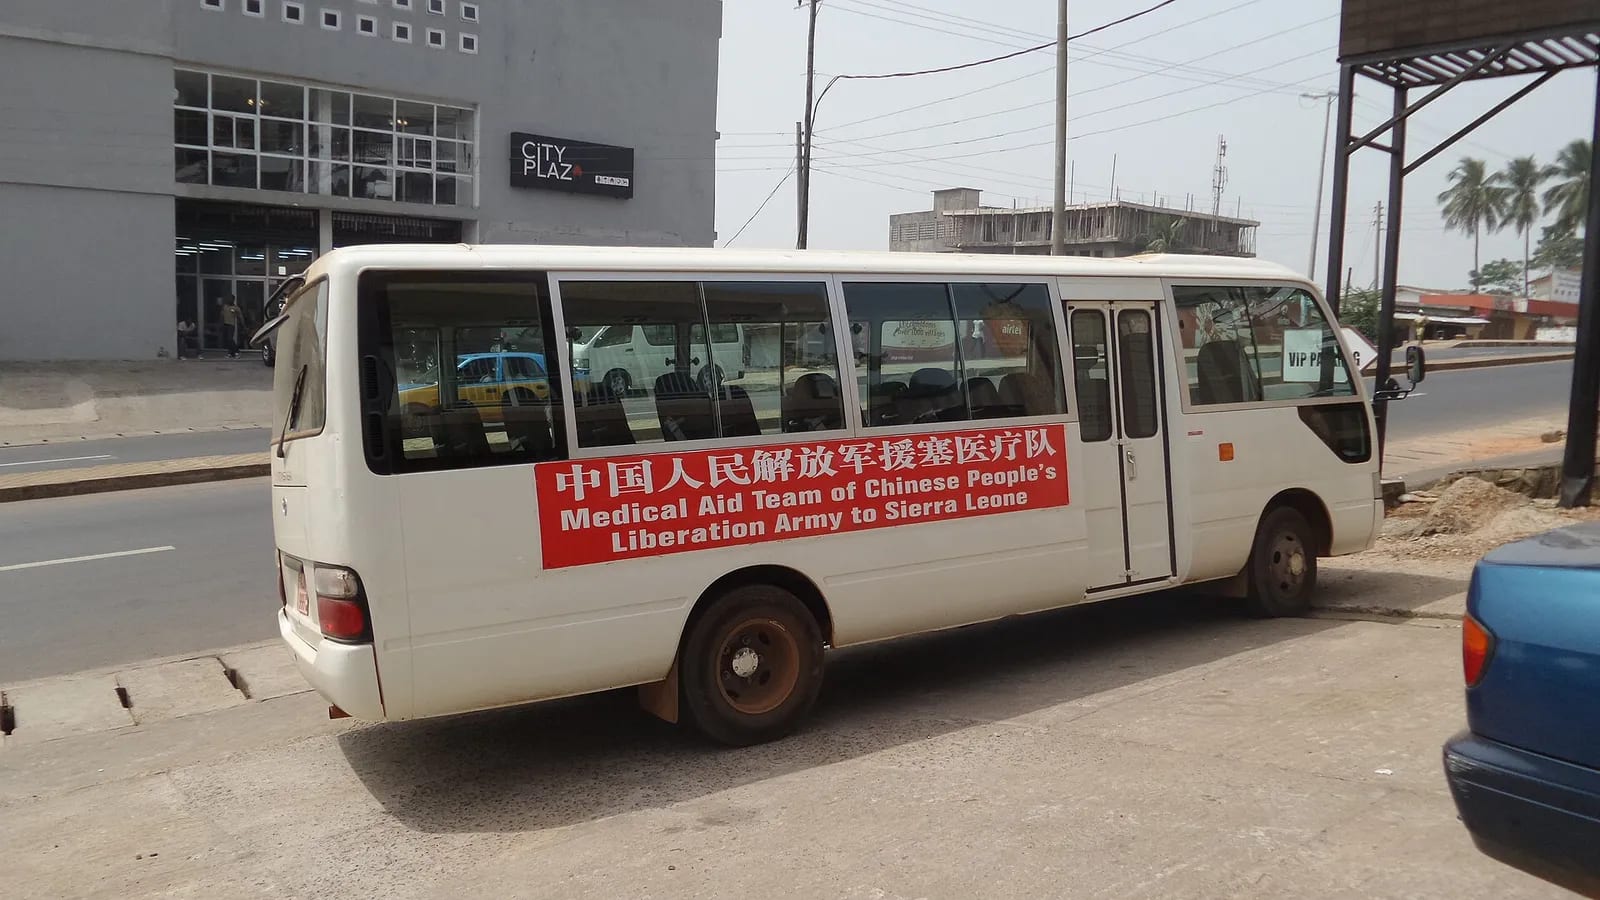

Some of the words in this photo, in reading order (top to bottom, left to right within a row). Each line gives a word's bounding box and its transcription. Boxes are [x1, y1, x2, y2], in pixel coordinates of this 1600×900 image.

[1288, 351, 1307, 367] VIP
[555, 428, 1057, 502] 中国人民解放军援塞医疗队
[560, 498, 688, 531] Medical
[698, 494, 744, 516] Aid
[751, 489, 822, 510] Team
[830, 481, 857, 502] of
[864, 475, 960, 498] Chinese
[967, 463, 1057, 488] People's
[611, 519, 765, 553] Liberation
[774, 511, 843, 534] Army
[850, 506, 878, 526] to
[884, 498, 958, 521] Sierra
[964, 490, 1029, 512] Leone
